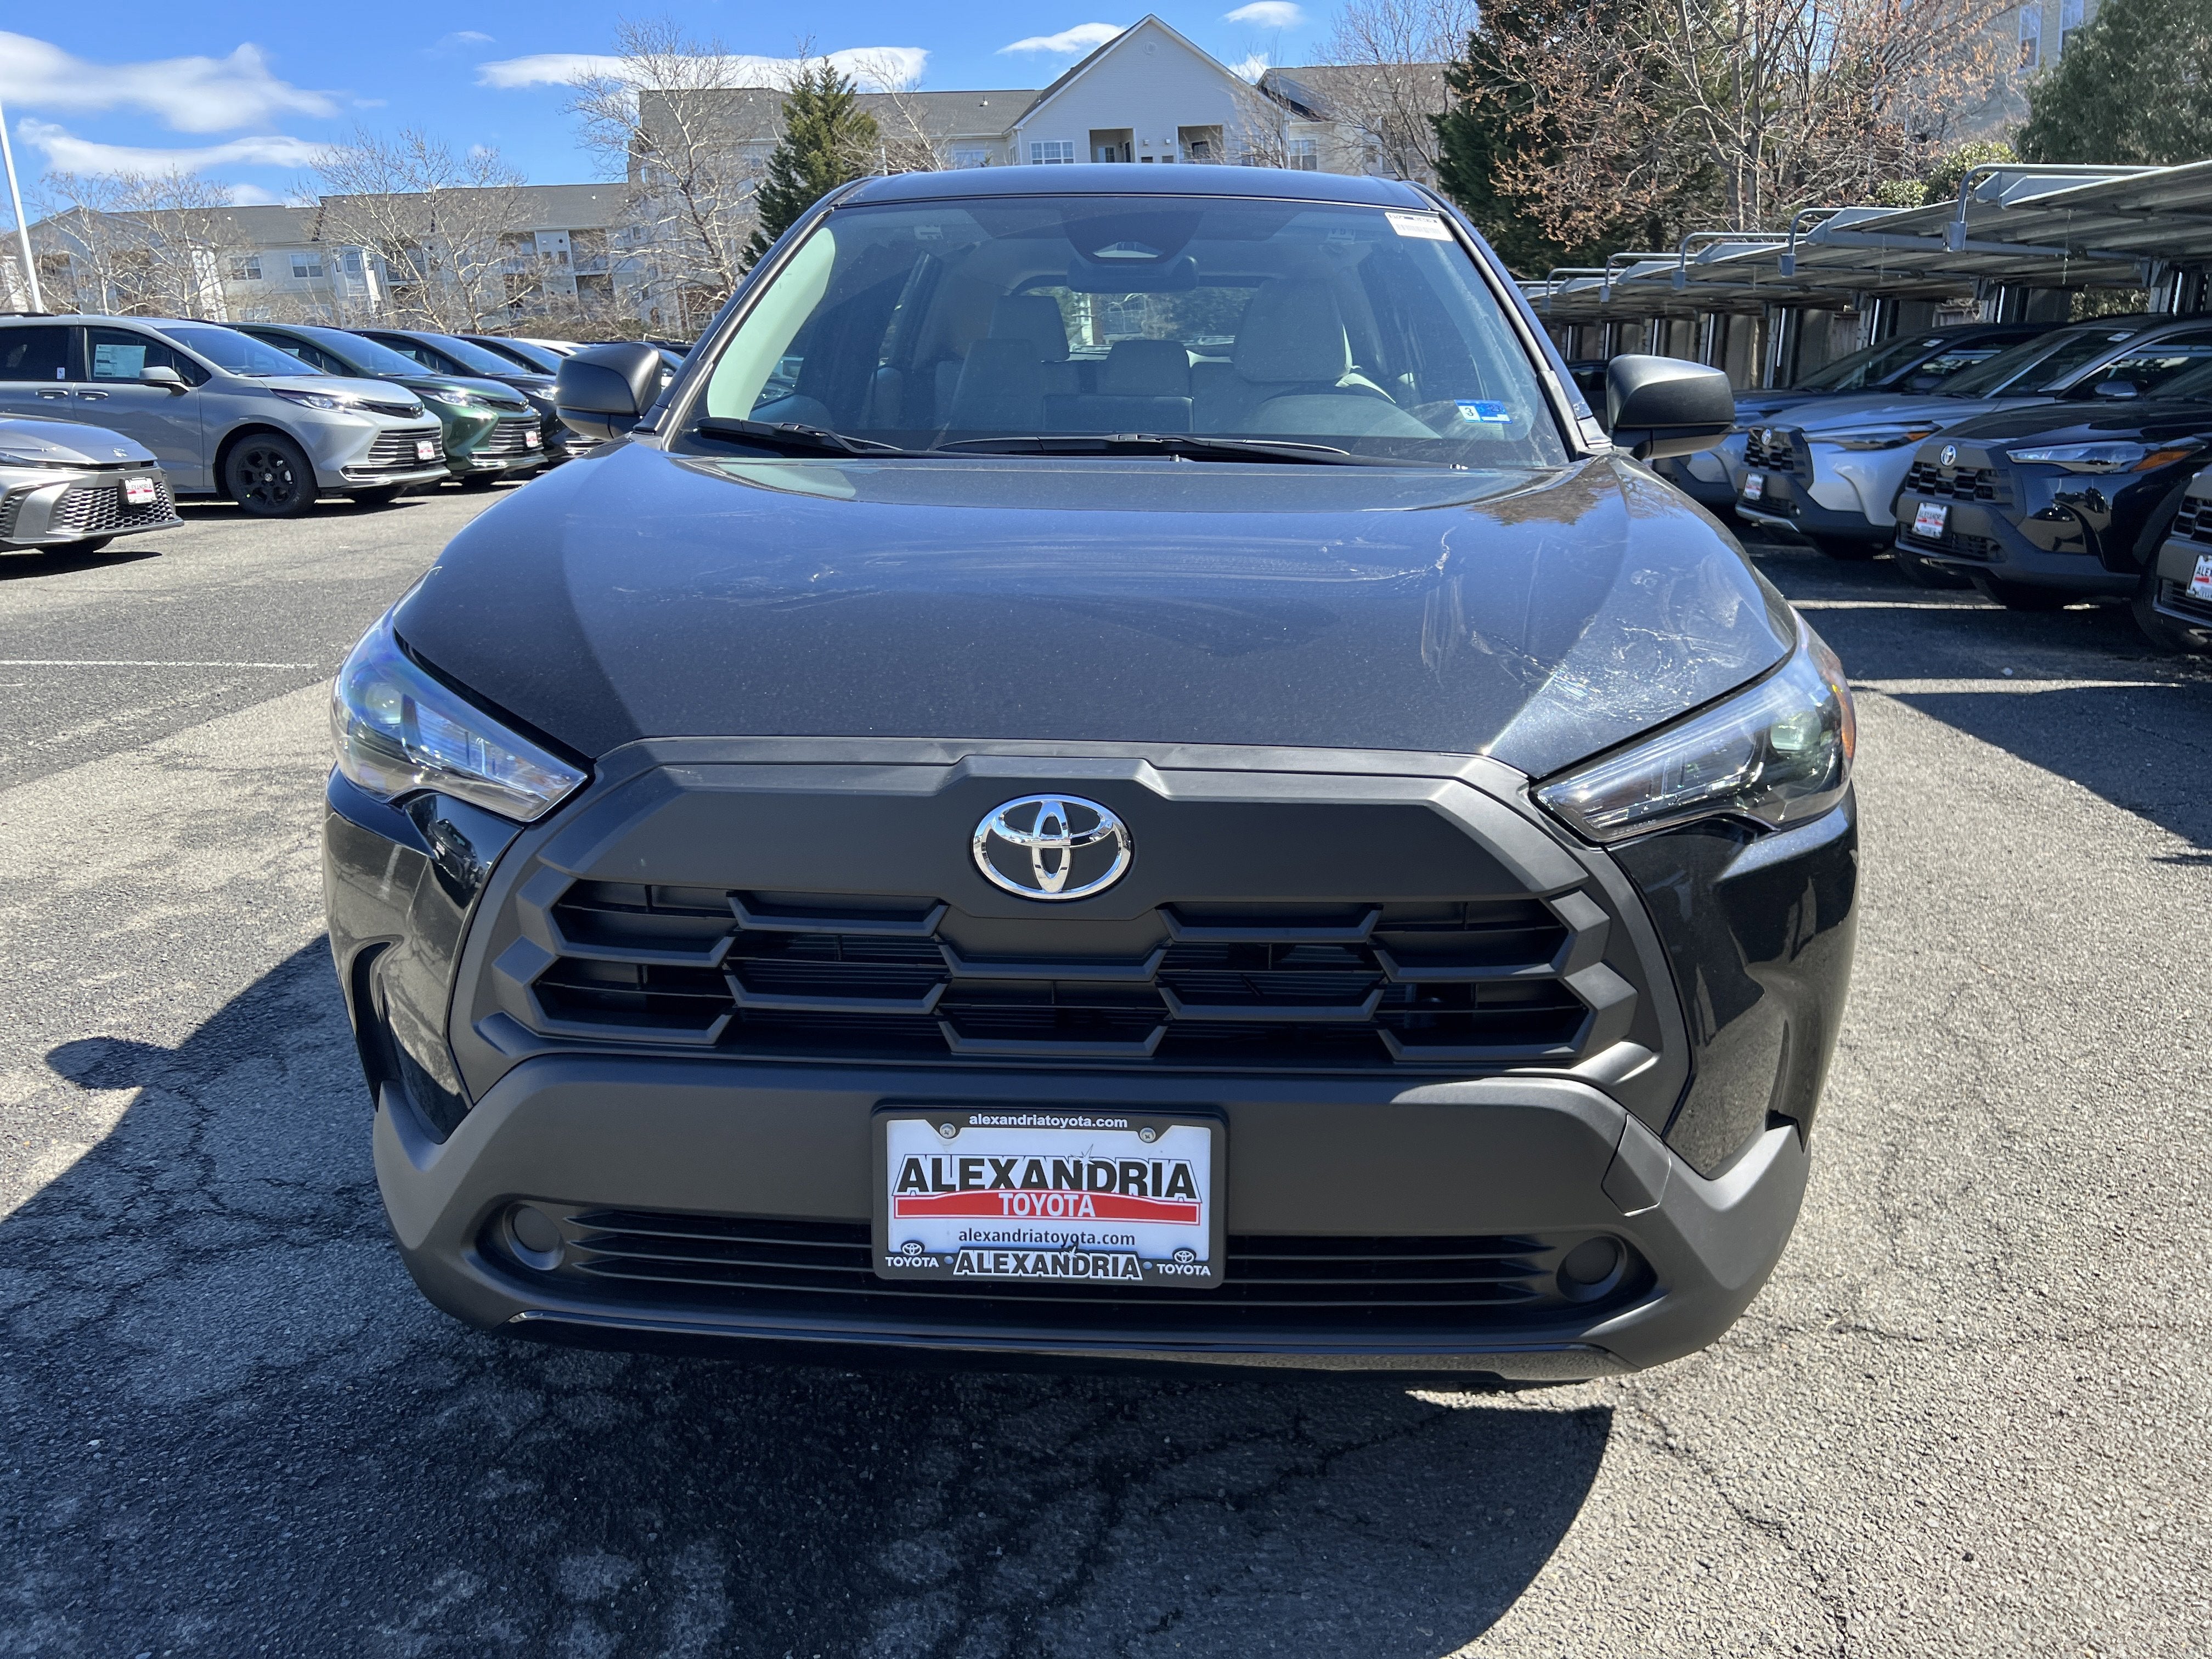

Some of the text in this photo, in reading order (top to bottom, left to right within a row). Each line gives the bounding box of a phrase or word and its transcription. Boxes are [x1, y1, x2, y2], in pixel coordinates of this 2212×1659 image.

[1465, 407, 1474, 416] 3
[969, 1114, 1128, 1128] alexandriatoyota.com
[894, 1155, 1200, 1201] ALEXANDRIA
[998, 1193, 1096, 1217] TOYOTA
[958, 1228, 1136, 1246] alexandriatoyota.com
[885, 1256, 939, 1269] TOYOTA
[954, 1250, 1143, 1280] ALEXANDRIA
[1157, 1263, 1211, 1277] TOYOTA
